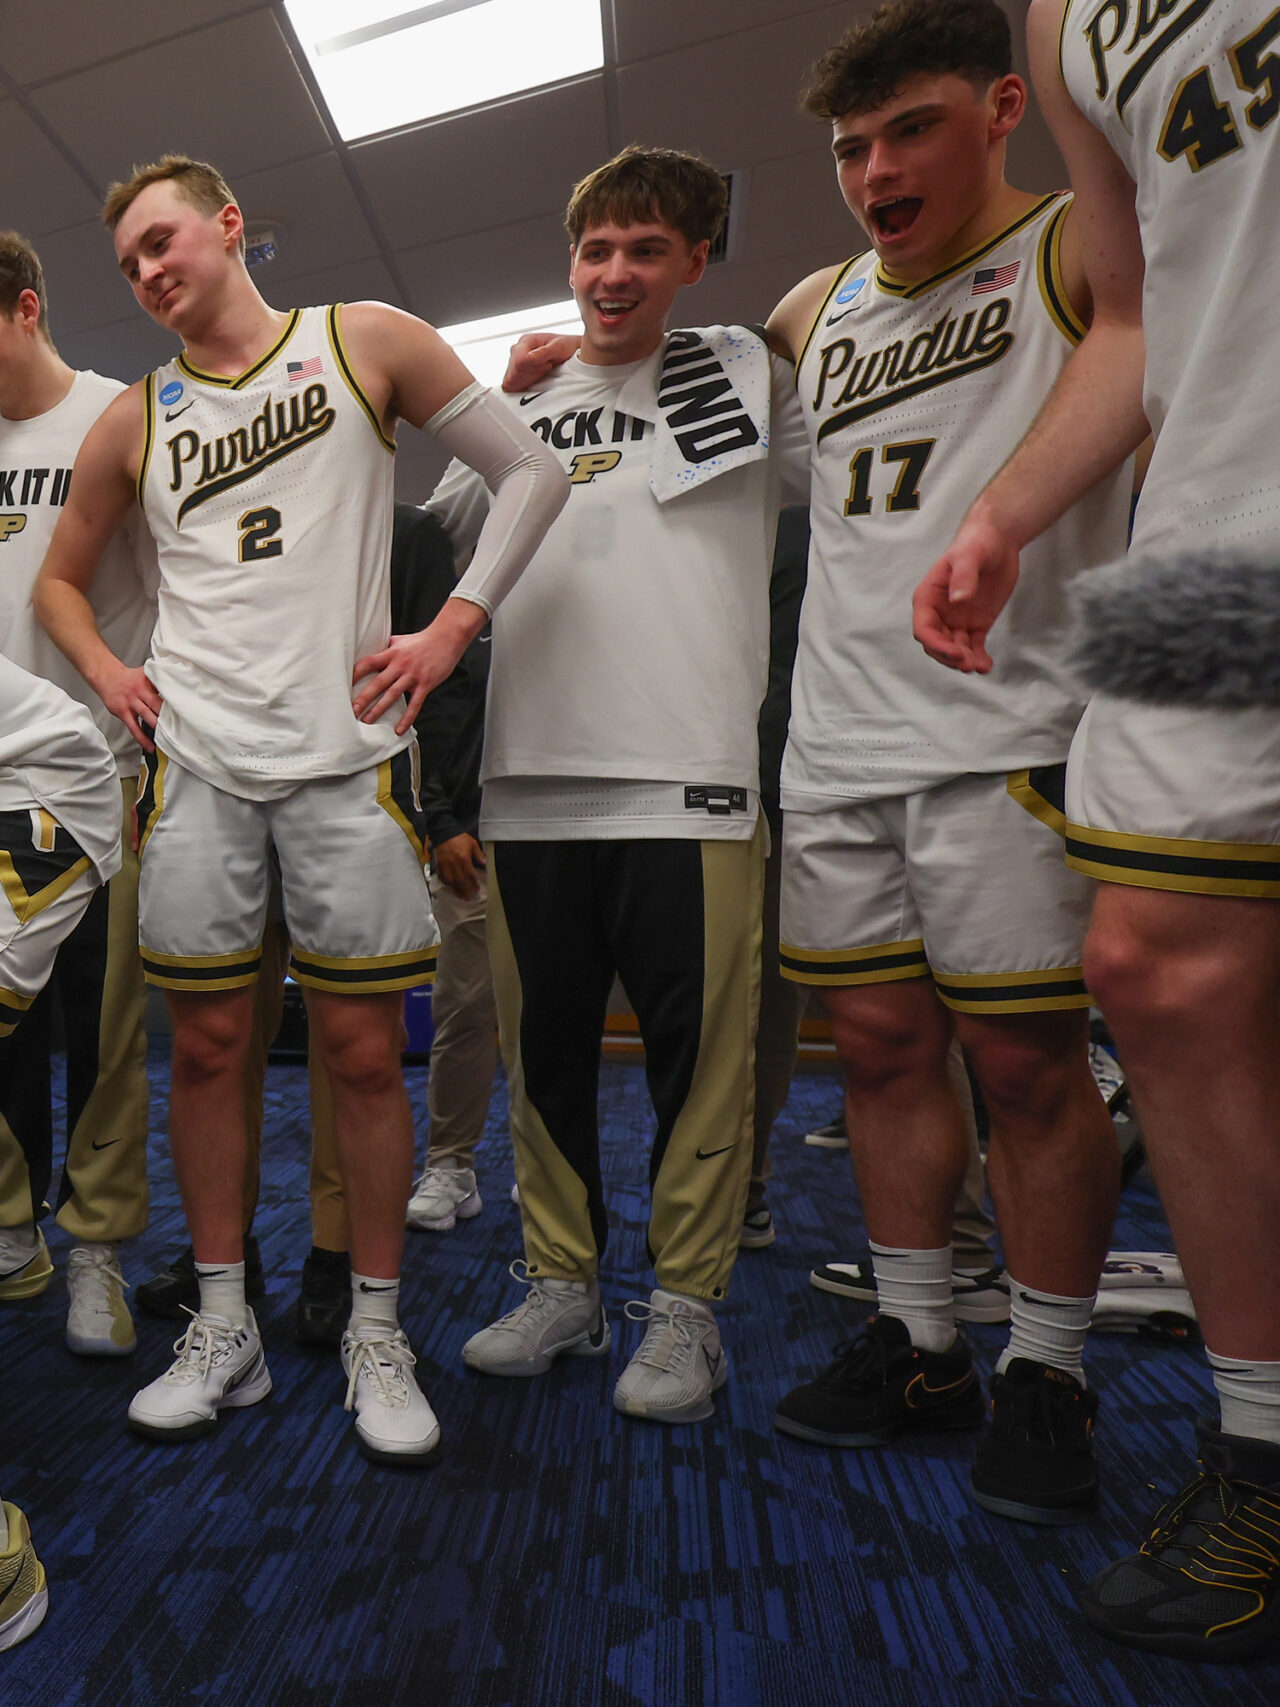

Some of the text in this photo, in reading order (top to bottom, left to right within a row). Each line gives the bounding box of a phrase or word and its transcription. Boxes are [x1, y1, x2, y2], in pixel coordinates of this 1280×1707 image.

[813, 297, 1015, 412] Purdue
[165, 383, 336, 492] Purdue
[530, 406, 603, 449] OCK
[20, 468, 50, 505] IT
[844, 438, 936, 517] 17
[238, 505, 283, 563] 2
